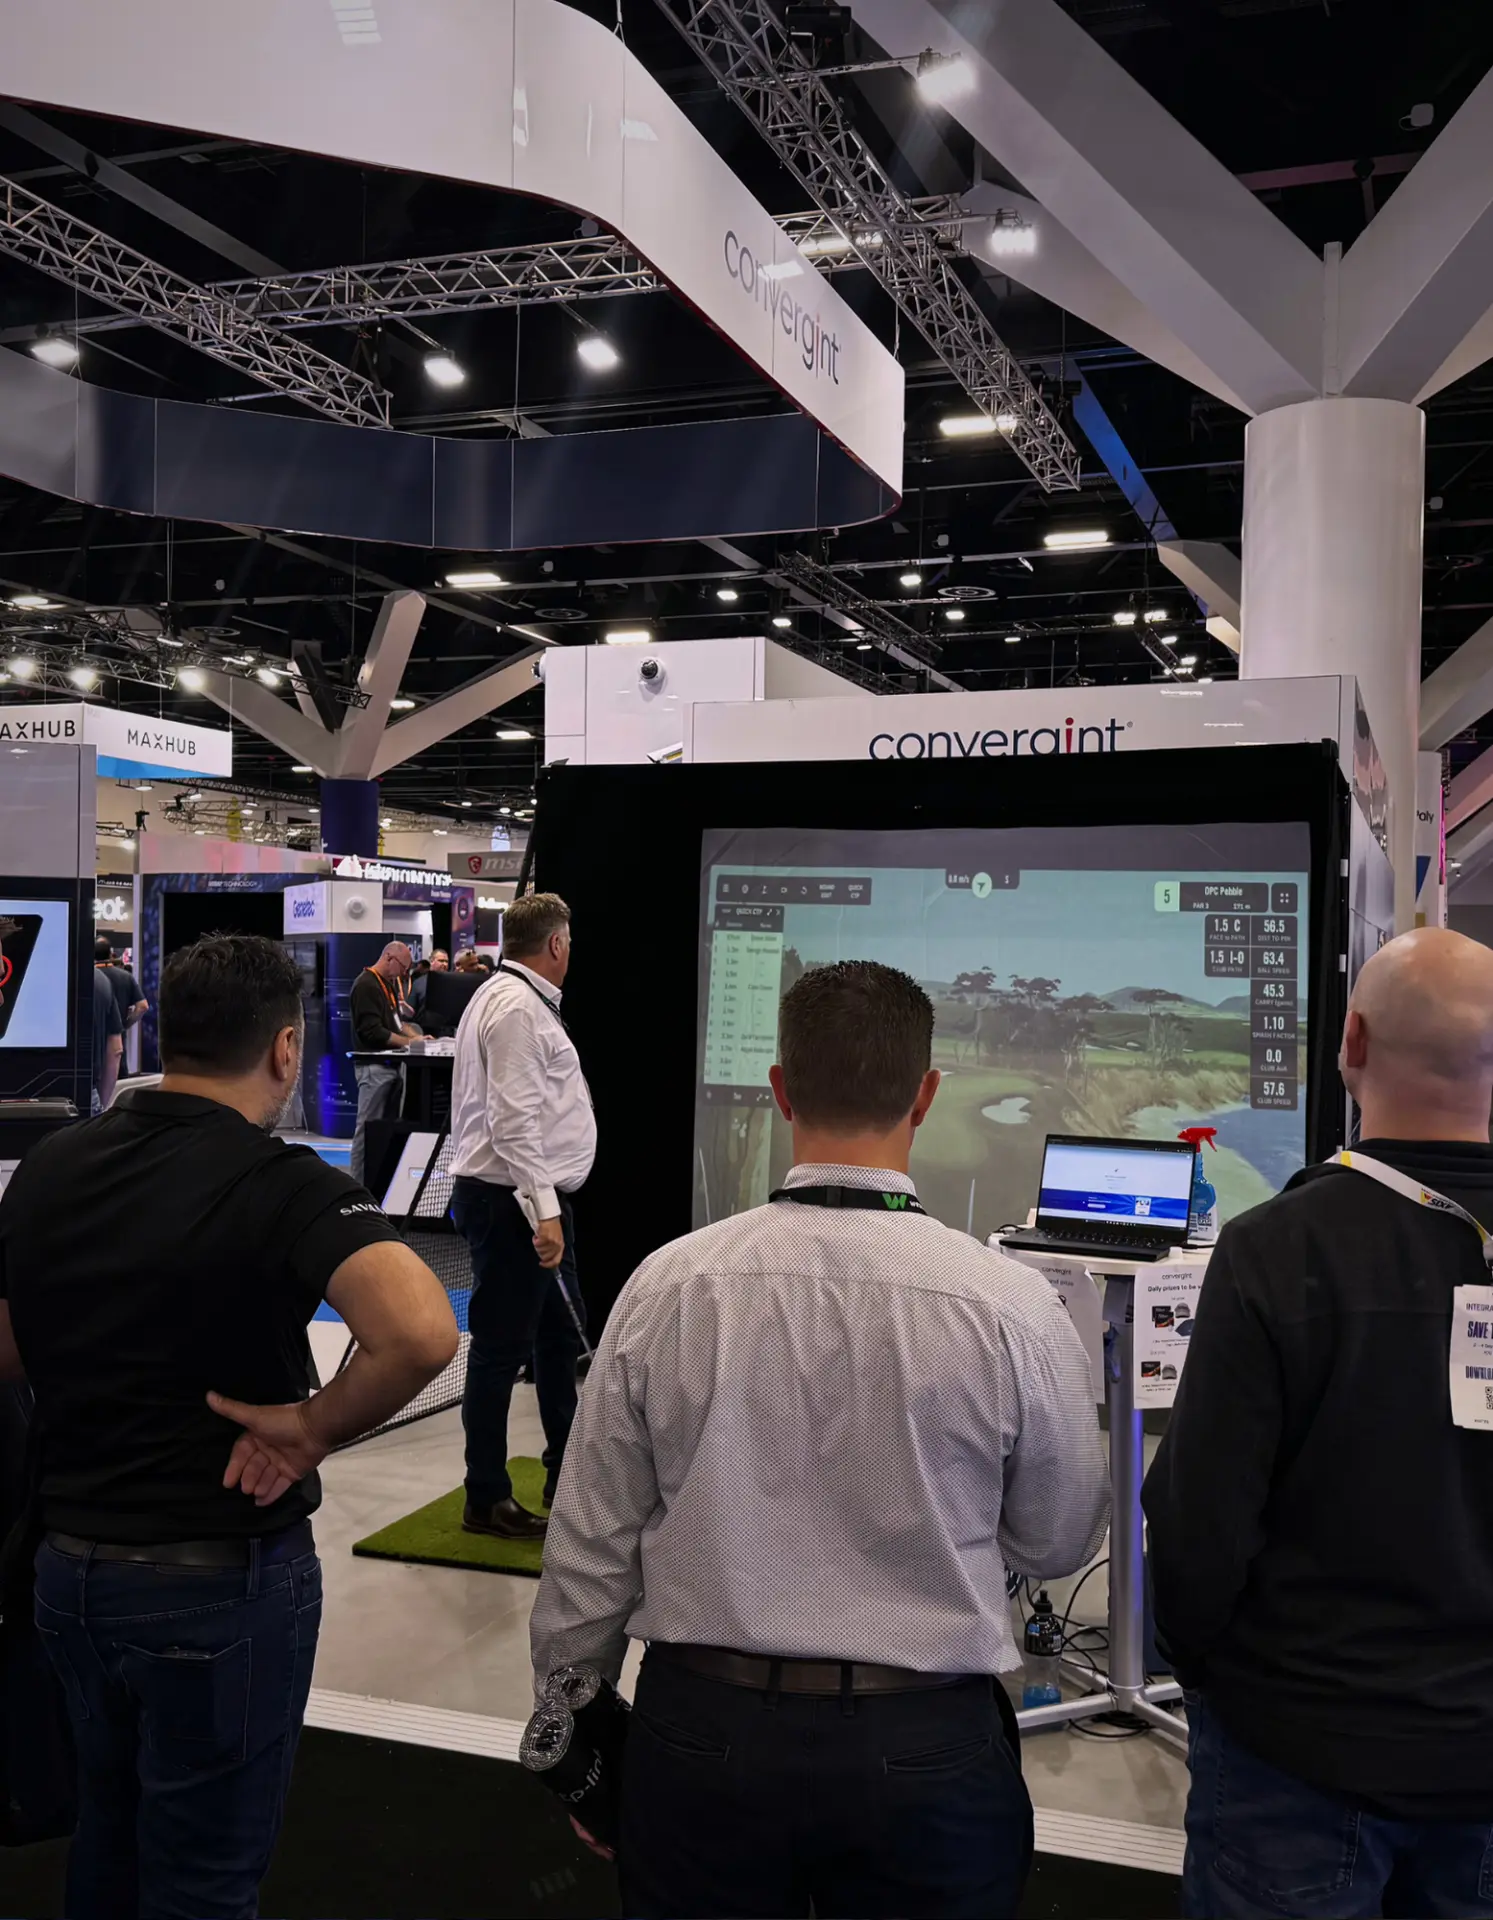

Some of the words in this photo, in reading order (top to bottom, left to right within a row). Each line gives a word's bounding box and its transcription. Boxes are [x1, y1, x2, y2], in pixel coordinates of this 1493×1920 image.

[127, 728, 196, 755] MAXHUB
[1163, 889, 1171, 904] 5
[1220, 886, 1243, 896] Pebble
[1214, 918, 1229, 932] 1.5
[1233, 918, 1241, 932] C
[1263, 919, 1285, 933] 56.5
[1210, 950, 1224, 964] 1.5
[1263, 951, 1285, 965] 63.4
[1263, 984, 1285, 998] 45.3
[1263, 1015, 1285, 1031] 1.10
[1265, 1048, 1282, 1063] 0.0
[1263, 1081, 1285, 1096] 57.6
[1161, 1272, 1193, 1280] convergint
[1147, 1285, 1162, 1293] Daily
[1163, 1284, 1180, 1292] prizes
[1467, 1320, 1489, 1339] SAVE
